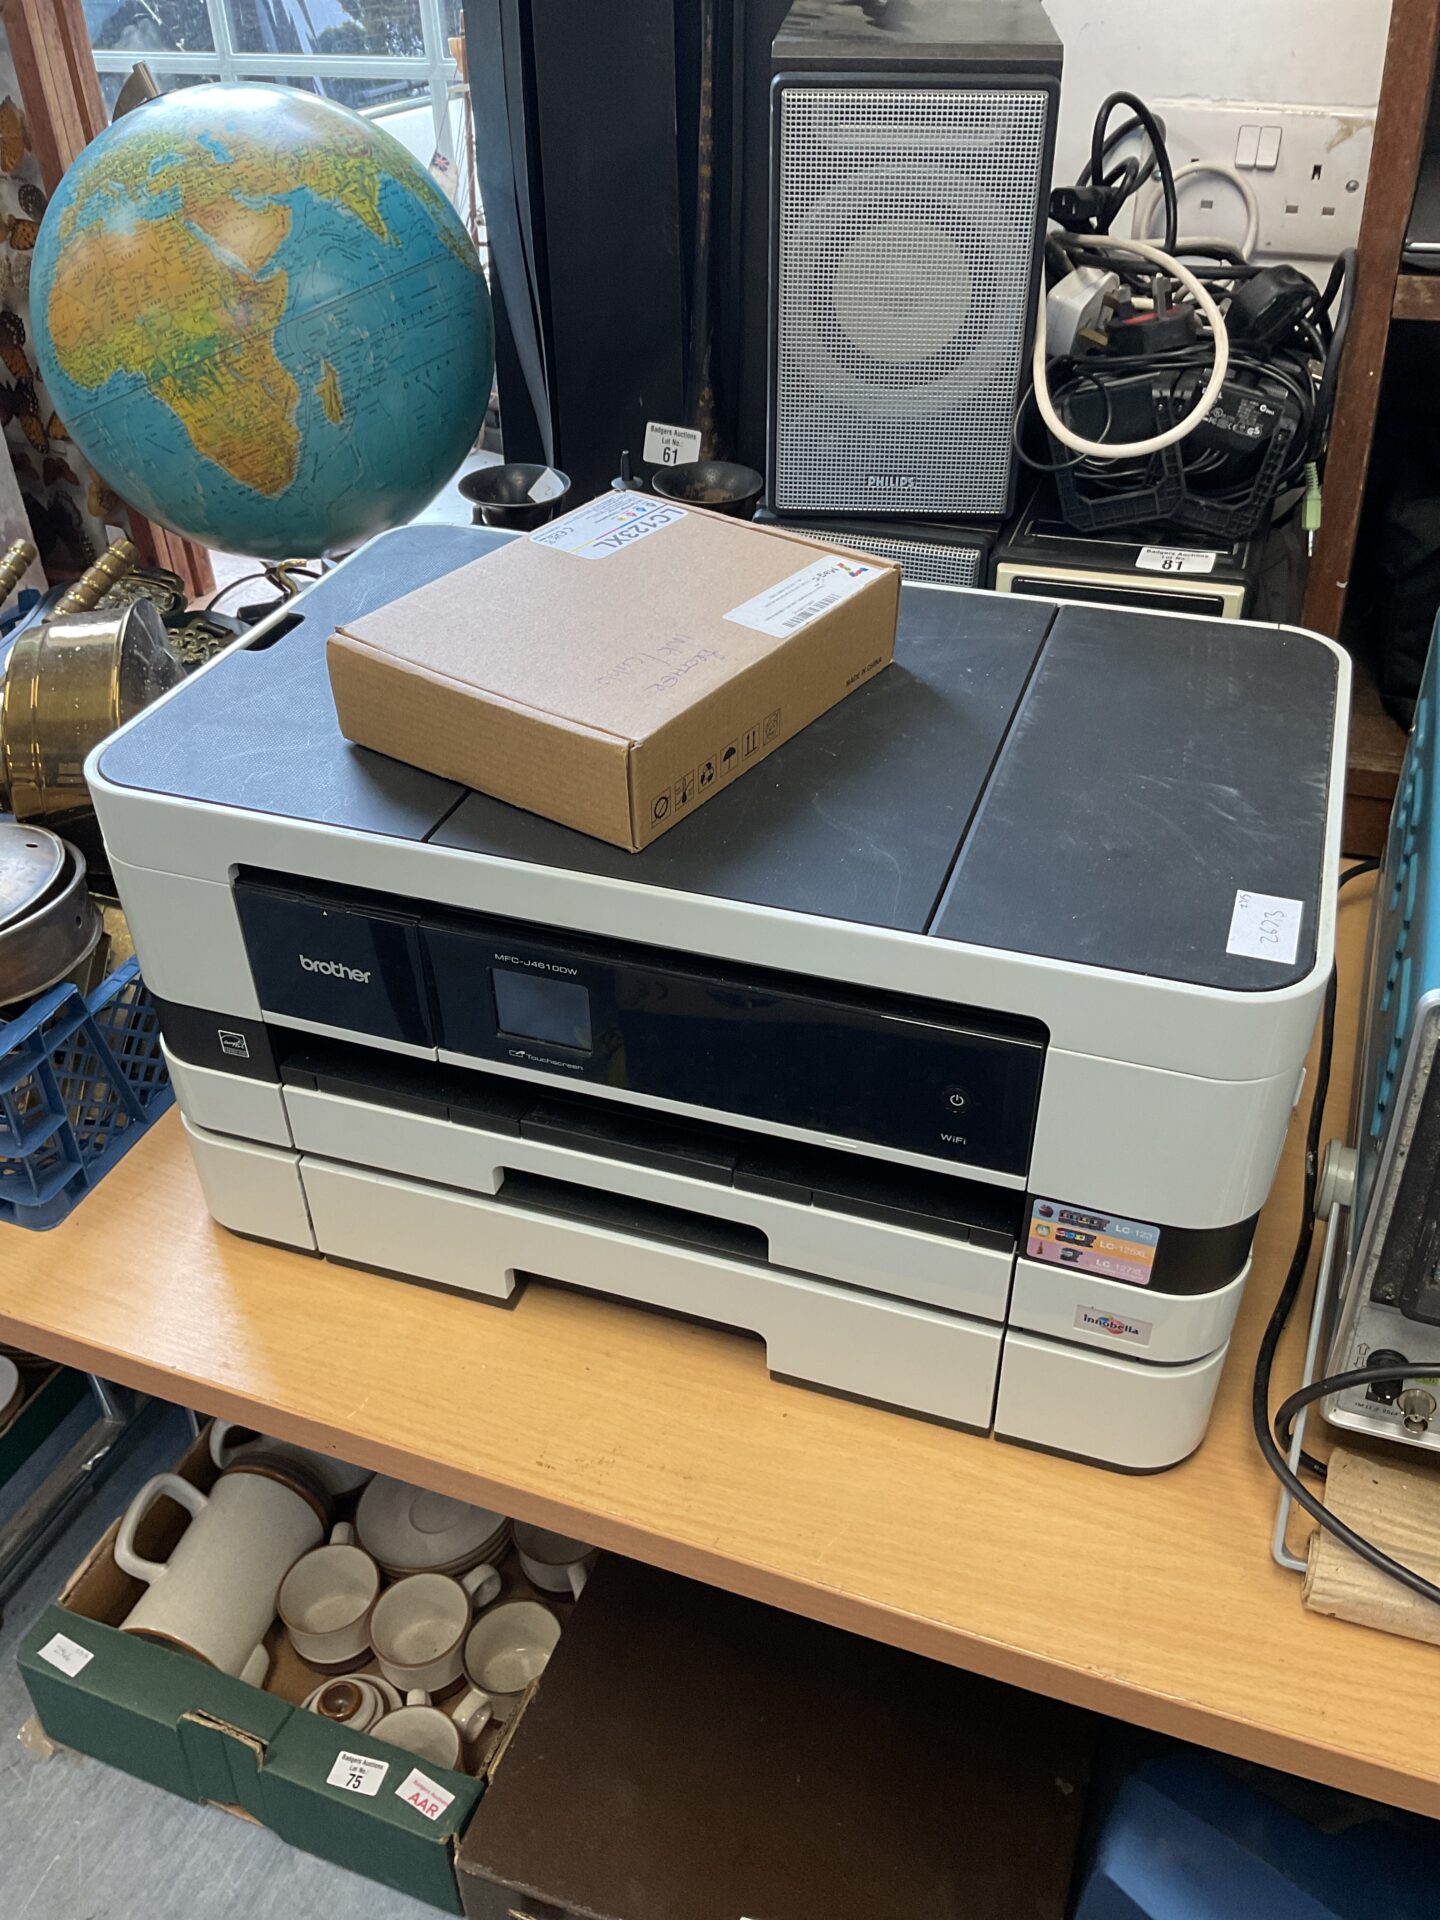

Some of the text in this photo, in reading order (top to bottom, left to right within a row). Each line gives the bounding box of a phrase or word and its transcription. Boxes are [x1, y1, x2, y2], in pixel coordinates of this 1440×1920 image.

[661, 437, 671, 445] Lot
[662, 446, 679, 465] 61
[867, 475, 915, 488] PHILIPS
[591, 507, 685, 548] LC123XL
[1161, 559, 1183, 571] 81
[299, 953, 371, 984] brother
[494, 953, 578, 976] MFC-J4610DW
[526, 1053, 584, 1071] Touchscreen
[940, 1132, 966, 1145] WiFi
[1083, 1314, 1140, 1335] Innobella
[345, 1773, 363, 1789] 75
[408, 1792, 439, 1818] AAR
